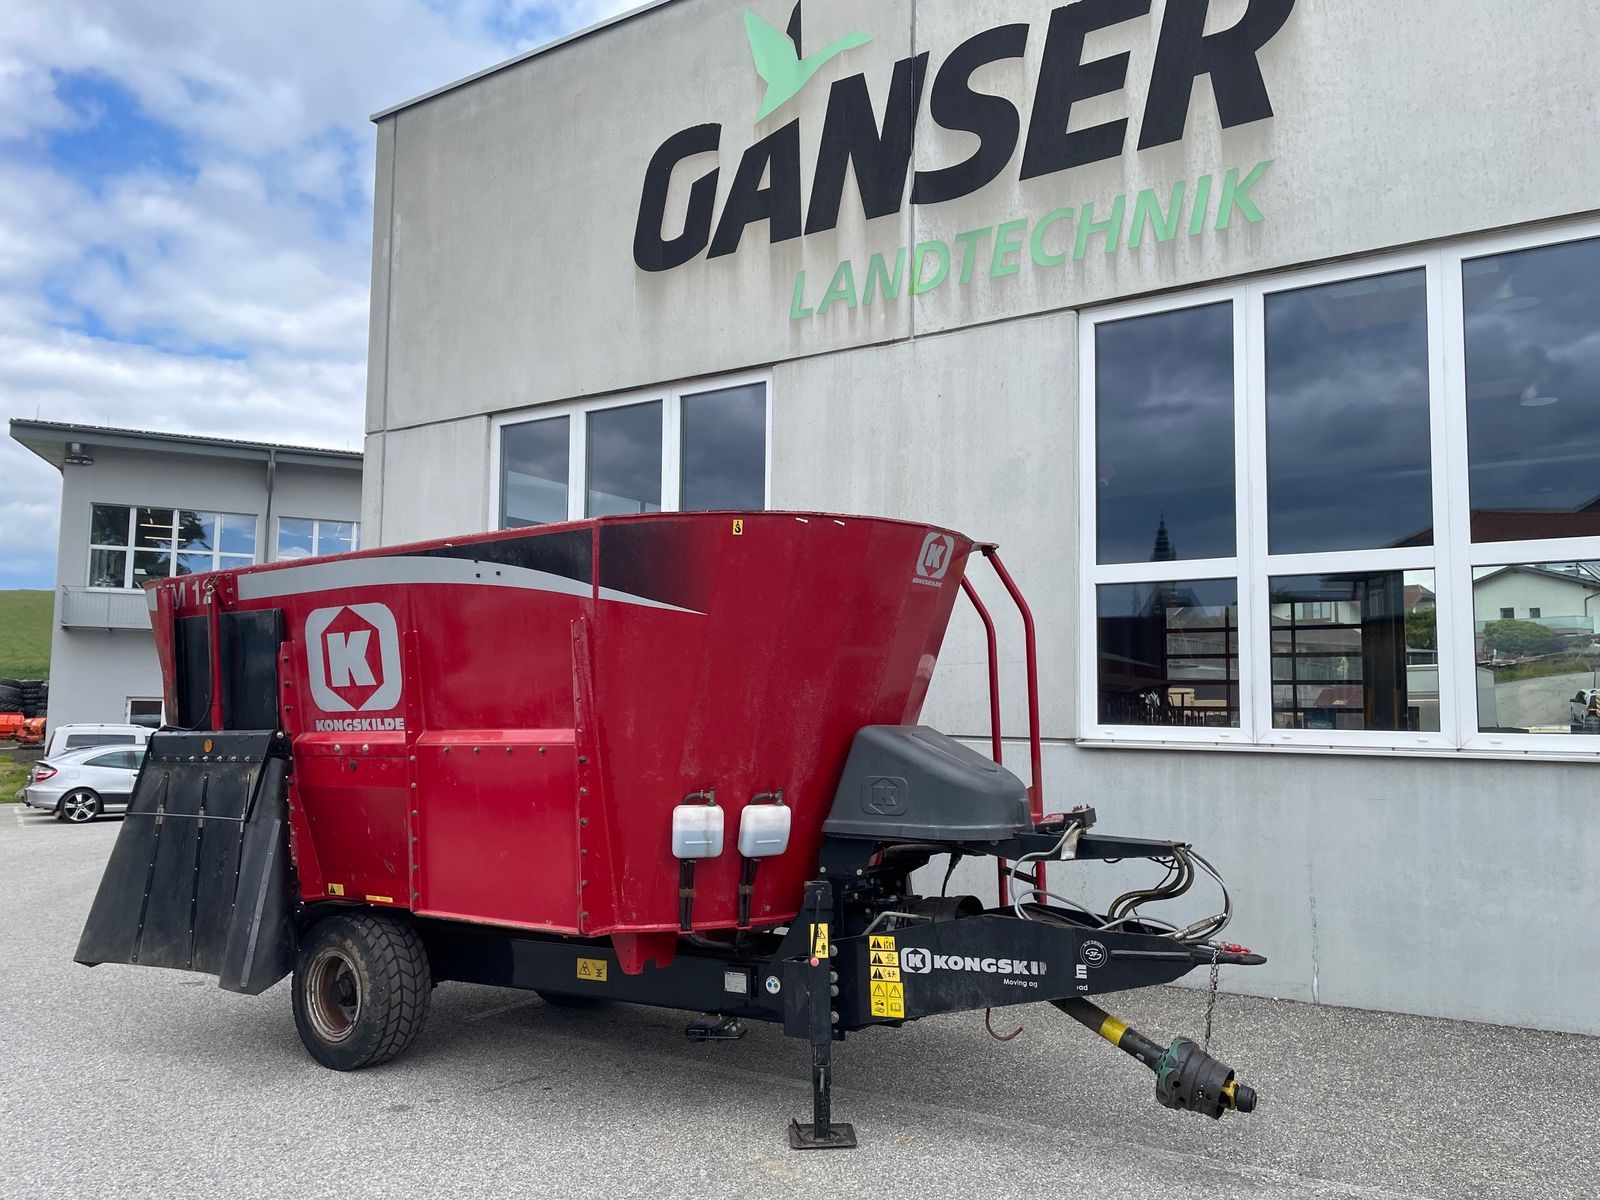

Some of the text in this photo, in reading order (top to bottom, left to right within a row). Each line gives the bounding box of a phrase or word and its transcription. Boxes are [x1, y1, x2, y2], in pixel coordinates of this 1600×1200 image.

[633, 0, 1295, 272] GANSER
[789, 159, 1275, 320] LANDTECHNIK
[315, 717, 405, 732] KONGSKILDE
[1003, 978, 1028, 987] Moving
